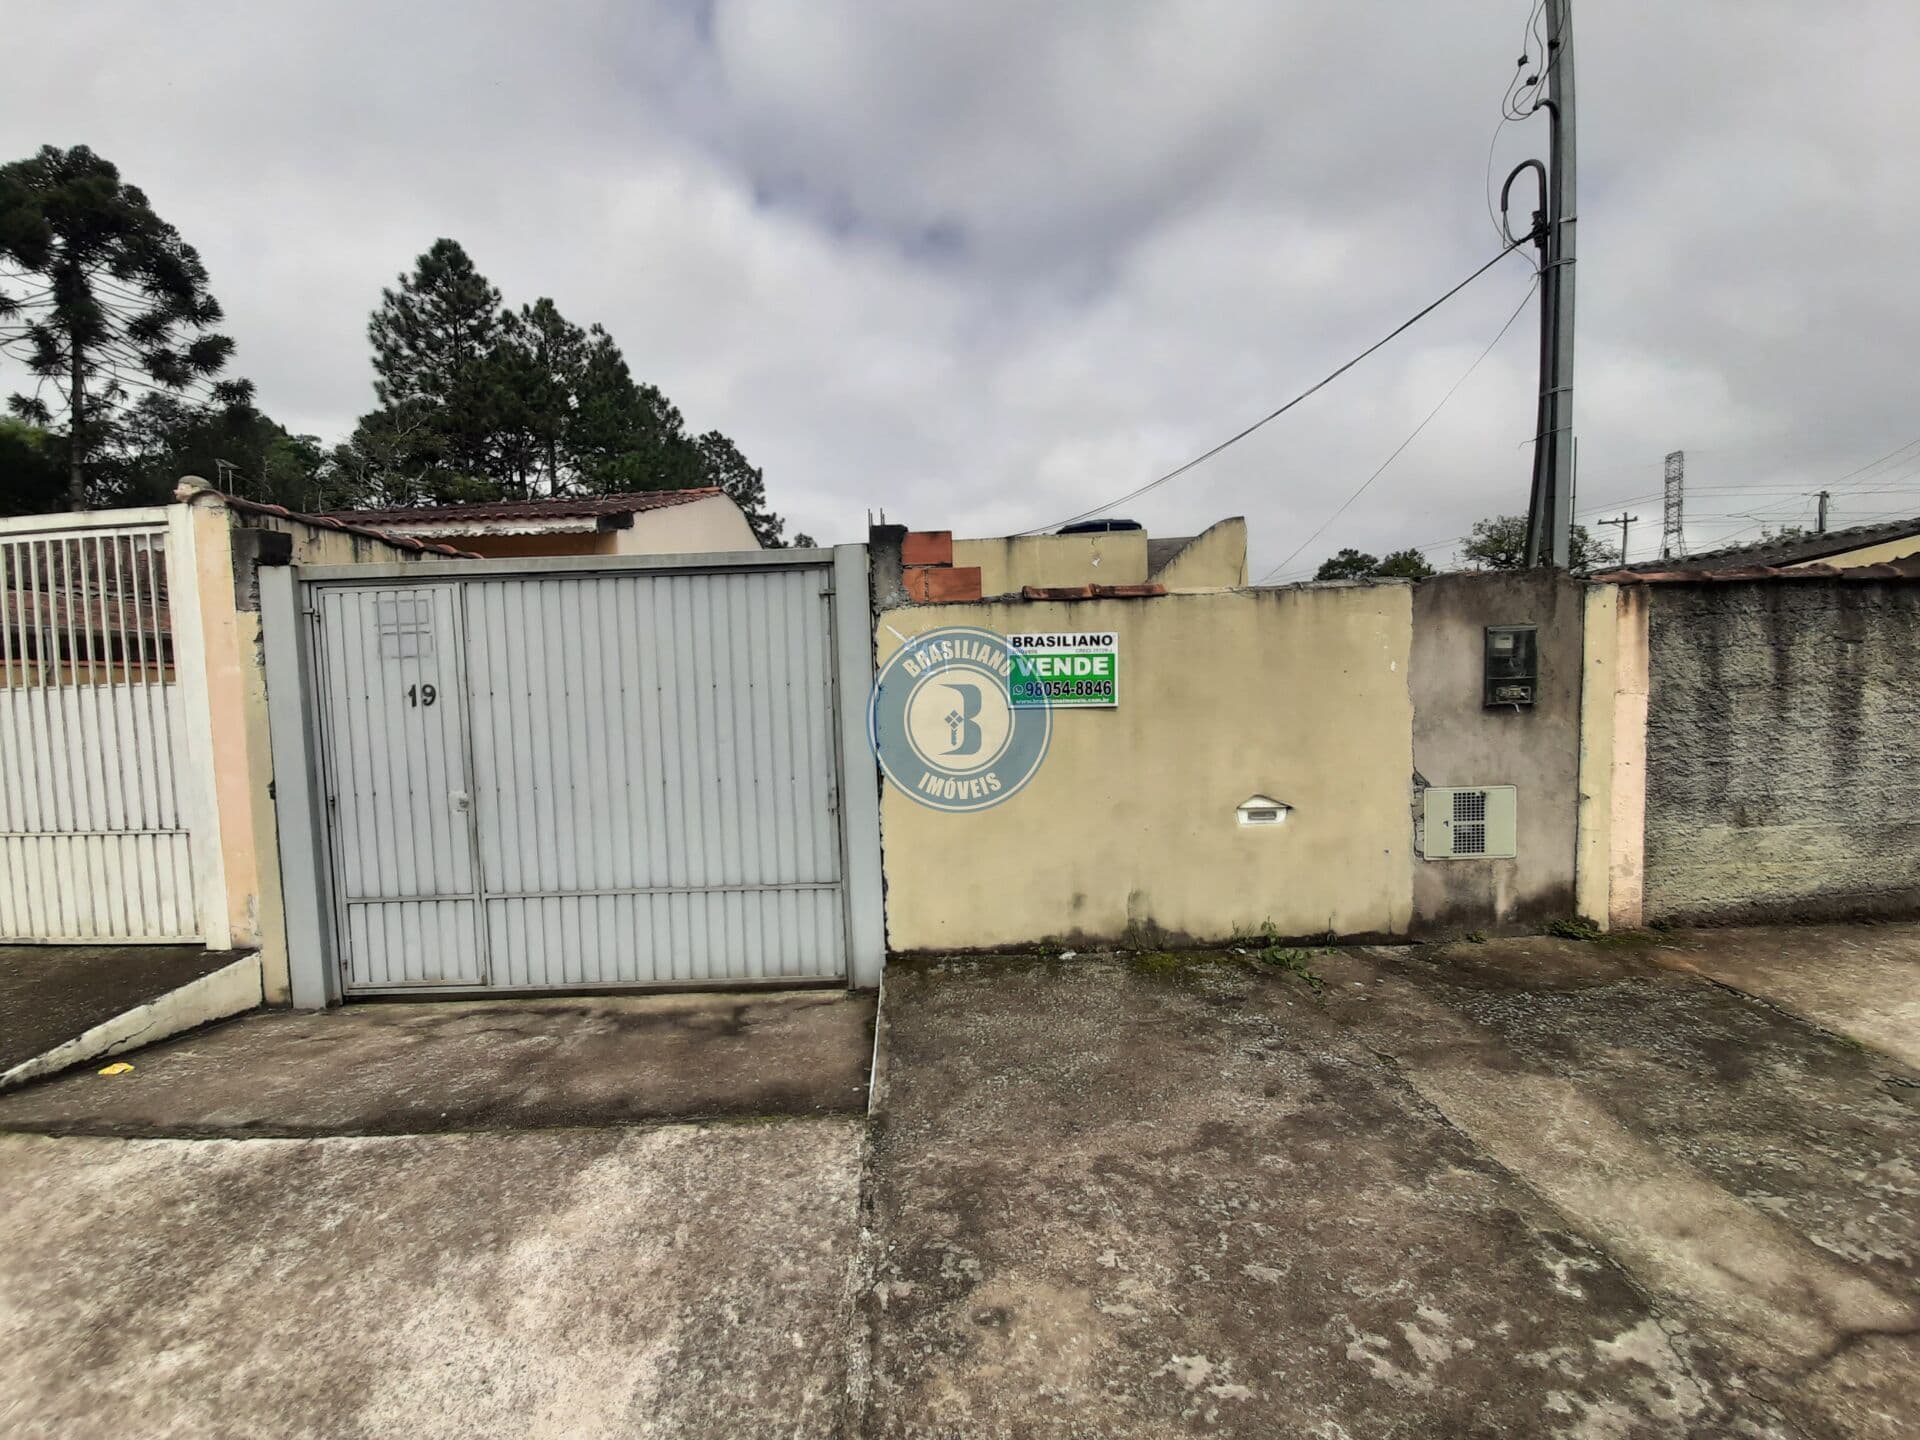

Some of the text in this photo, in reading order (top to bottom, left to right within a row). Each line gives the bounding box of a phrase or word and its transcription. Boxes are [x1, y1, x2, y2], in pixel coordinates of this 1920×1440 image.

[1012, 635, 1113, 648] BRASILIANO
[1015, 656, 1110, 677] VENDE
[408, 684, 437, 708] 19
[1025, 680, 1112, 697] 98054-8846
